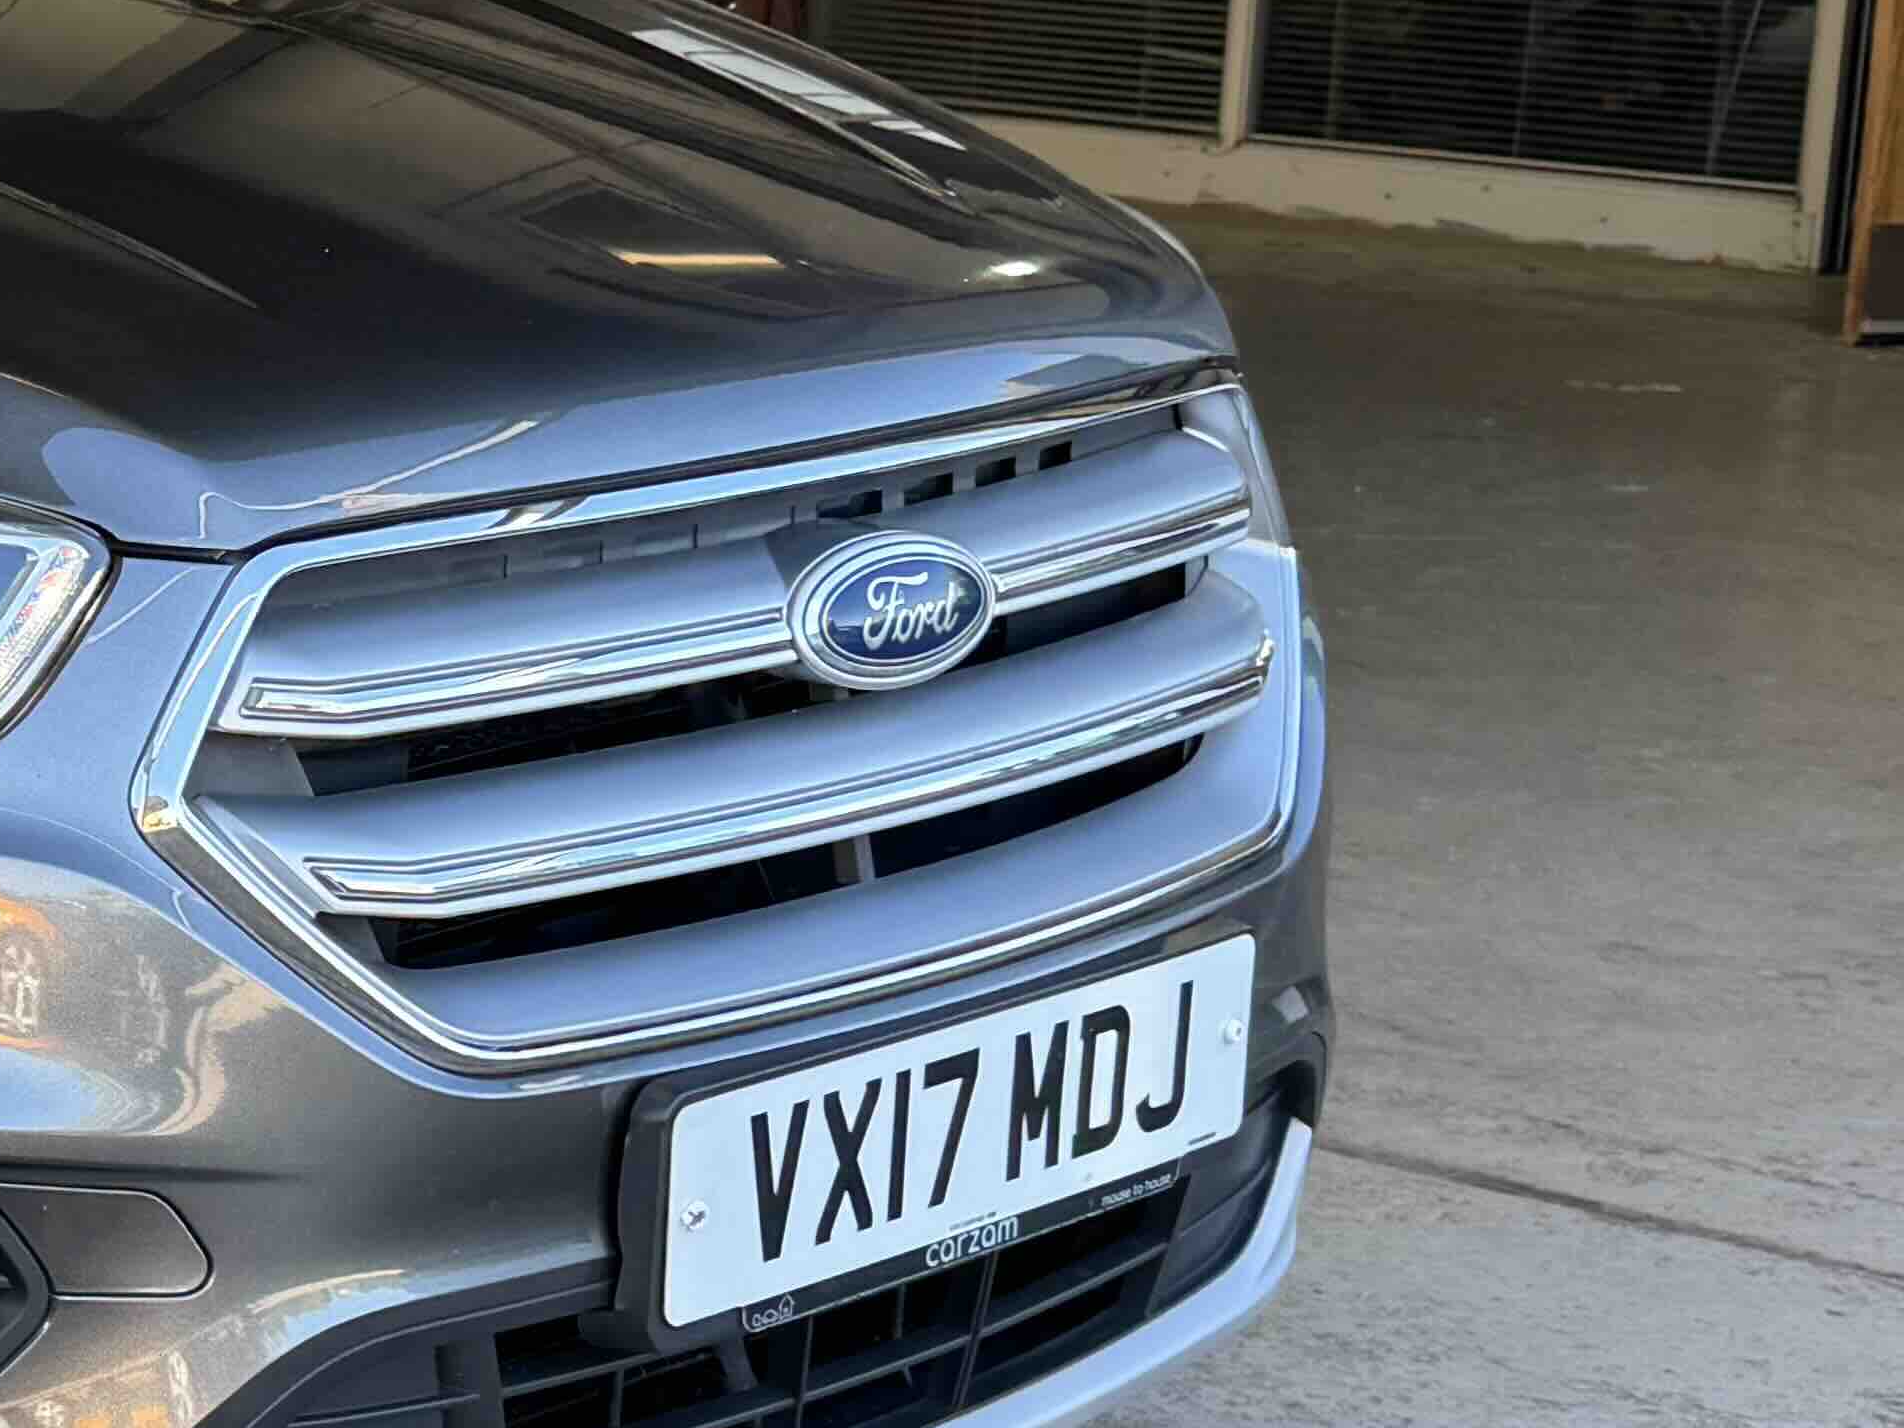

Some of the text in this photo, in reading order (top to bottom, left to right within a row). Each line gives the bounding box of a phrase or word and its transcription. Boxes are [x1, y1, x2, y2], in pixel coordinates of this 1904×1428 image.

[863, 571, 959, 649] Ford
[751, 980, 1193, 1262] VX17 MDJ
[925, 1216, 1018, 1267] carzam
